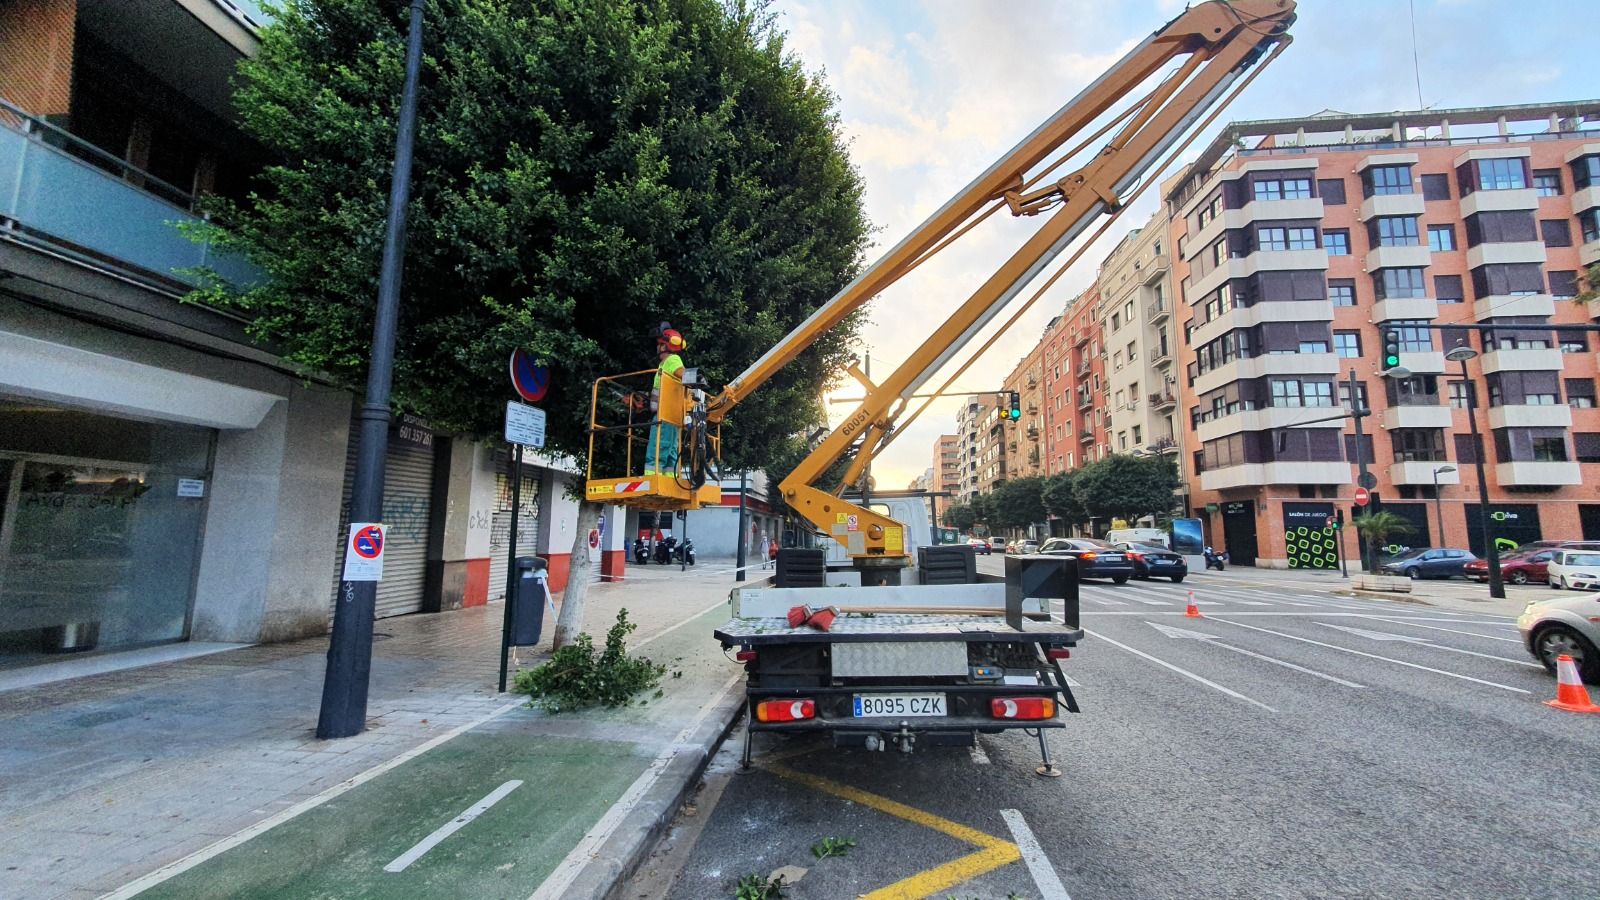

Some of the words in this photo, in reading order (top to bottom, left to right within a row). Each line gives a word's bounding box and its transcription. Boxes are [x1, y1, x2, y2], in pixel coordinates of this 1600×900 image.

[842, 408, 870, 436] 60051
[864, 698, 905, 714] 8095
[910, 698, 941, 714] CZK
